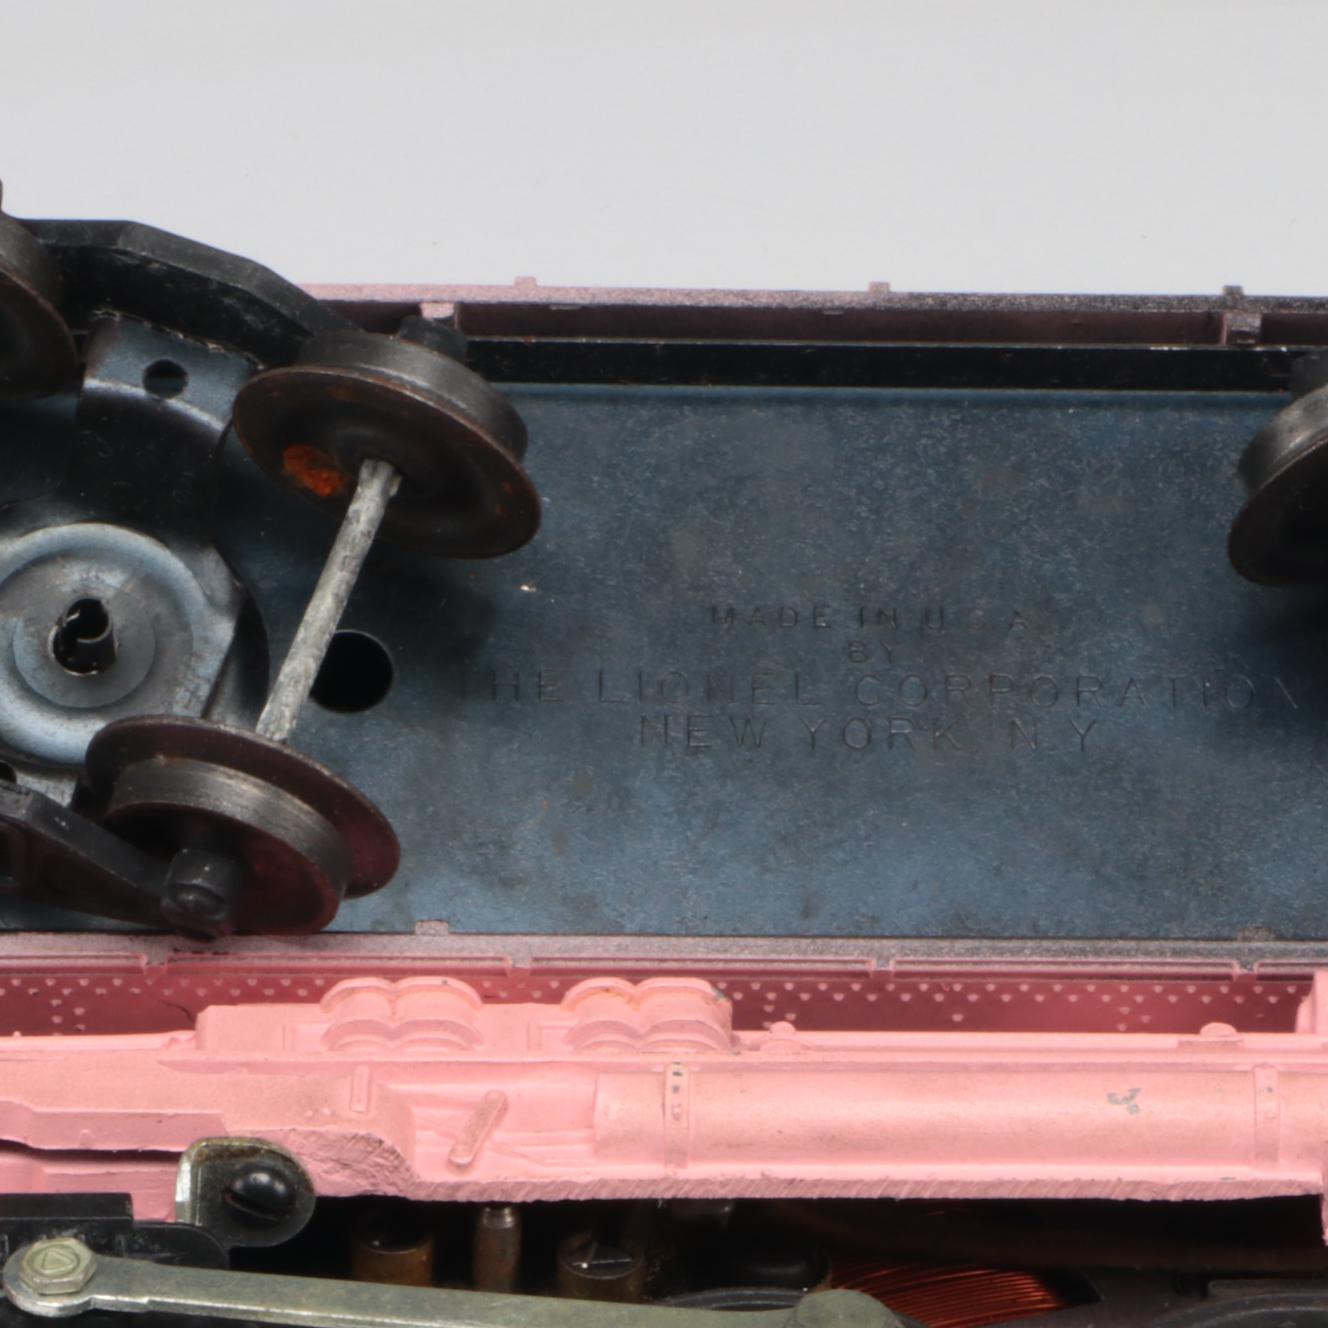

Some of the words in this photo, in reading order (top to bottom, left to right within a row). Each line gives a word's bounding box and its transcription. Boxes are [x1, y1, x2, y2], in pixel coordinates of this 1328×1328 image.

[848, 639, 895, 664] BY
[597, 669, 824, 706] LIONEL
[640, 713, 769, 749] NEW
[799, 716, 962, 751] YORK
